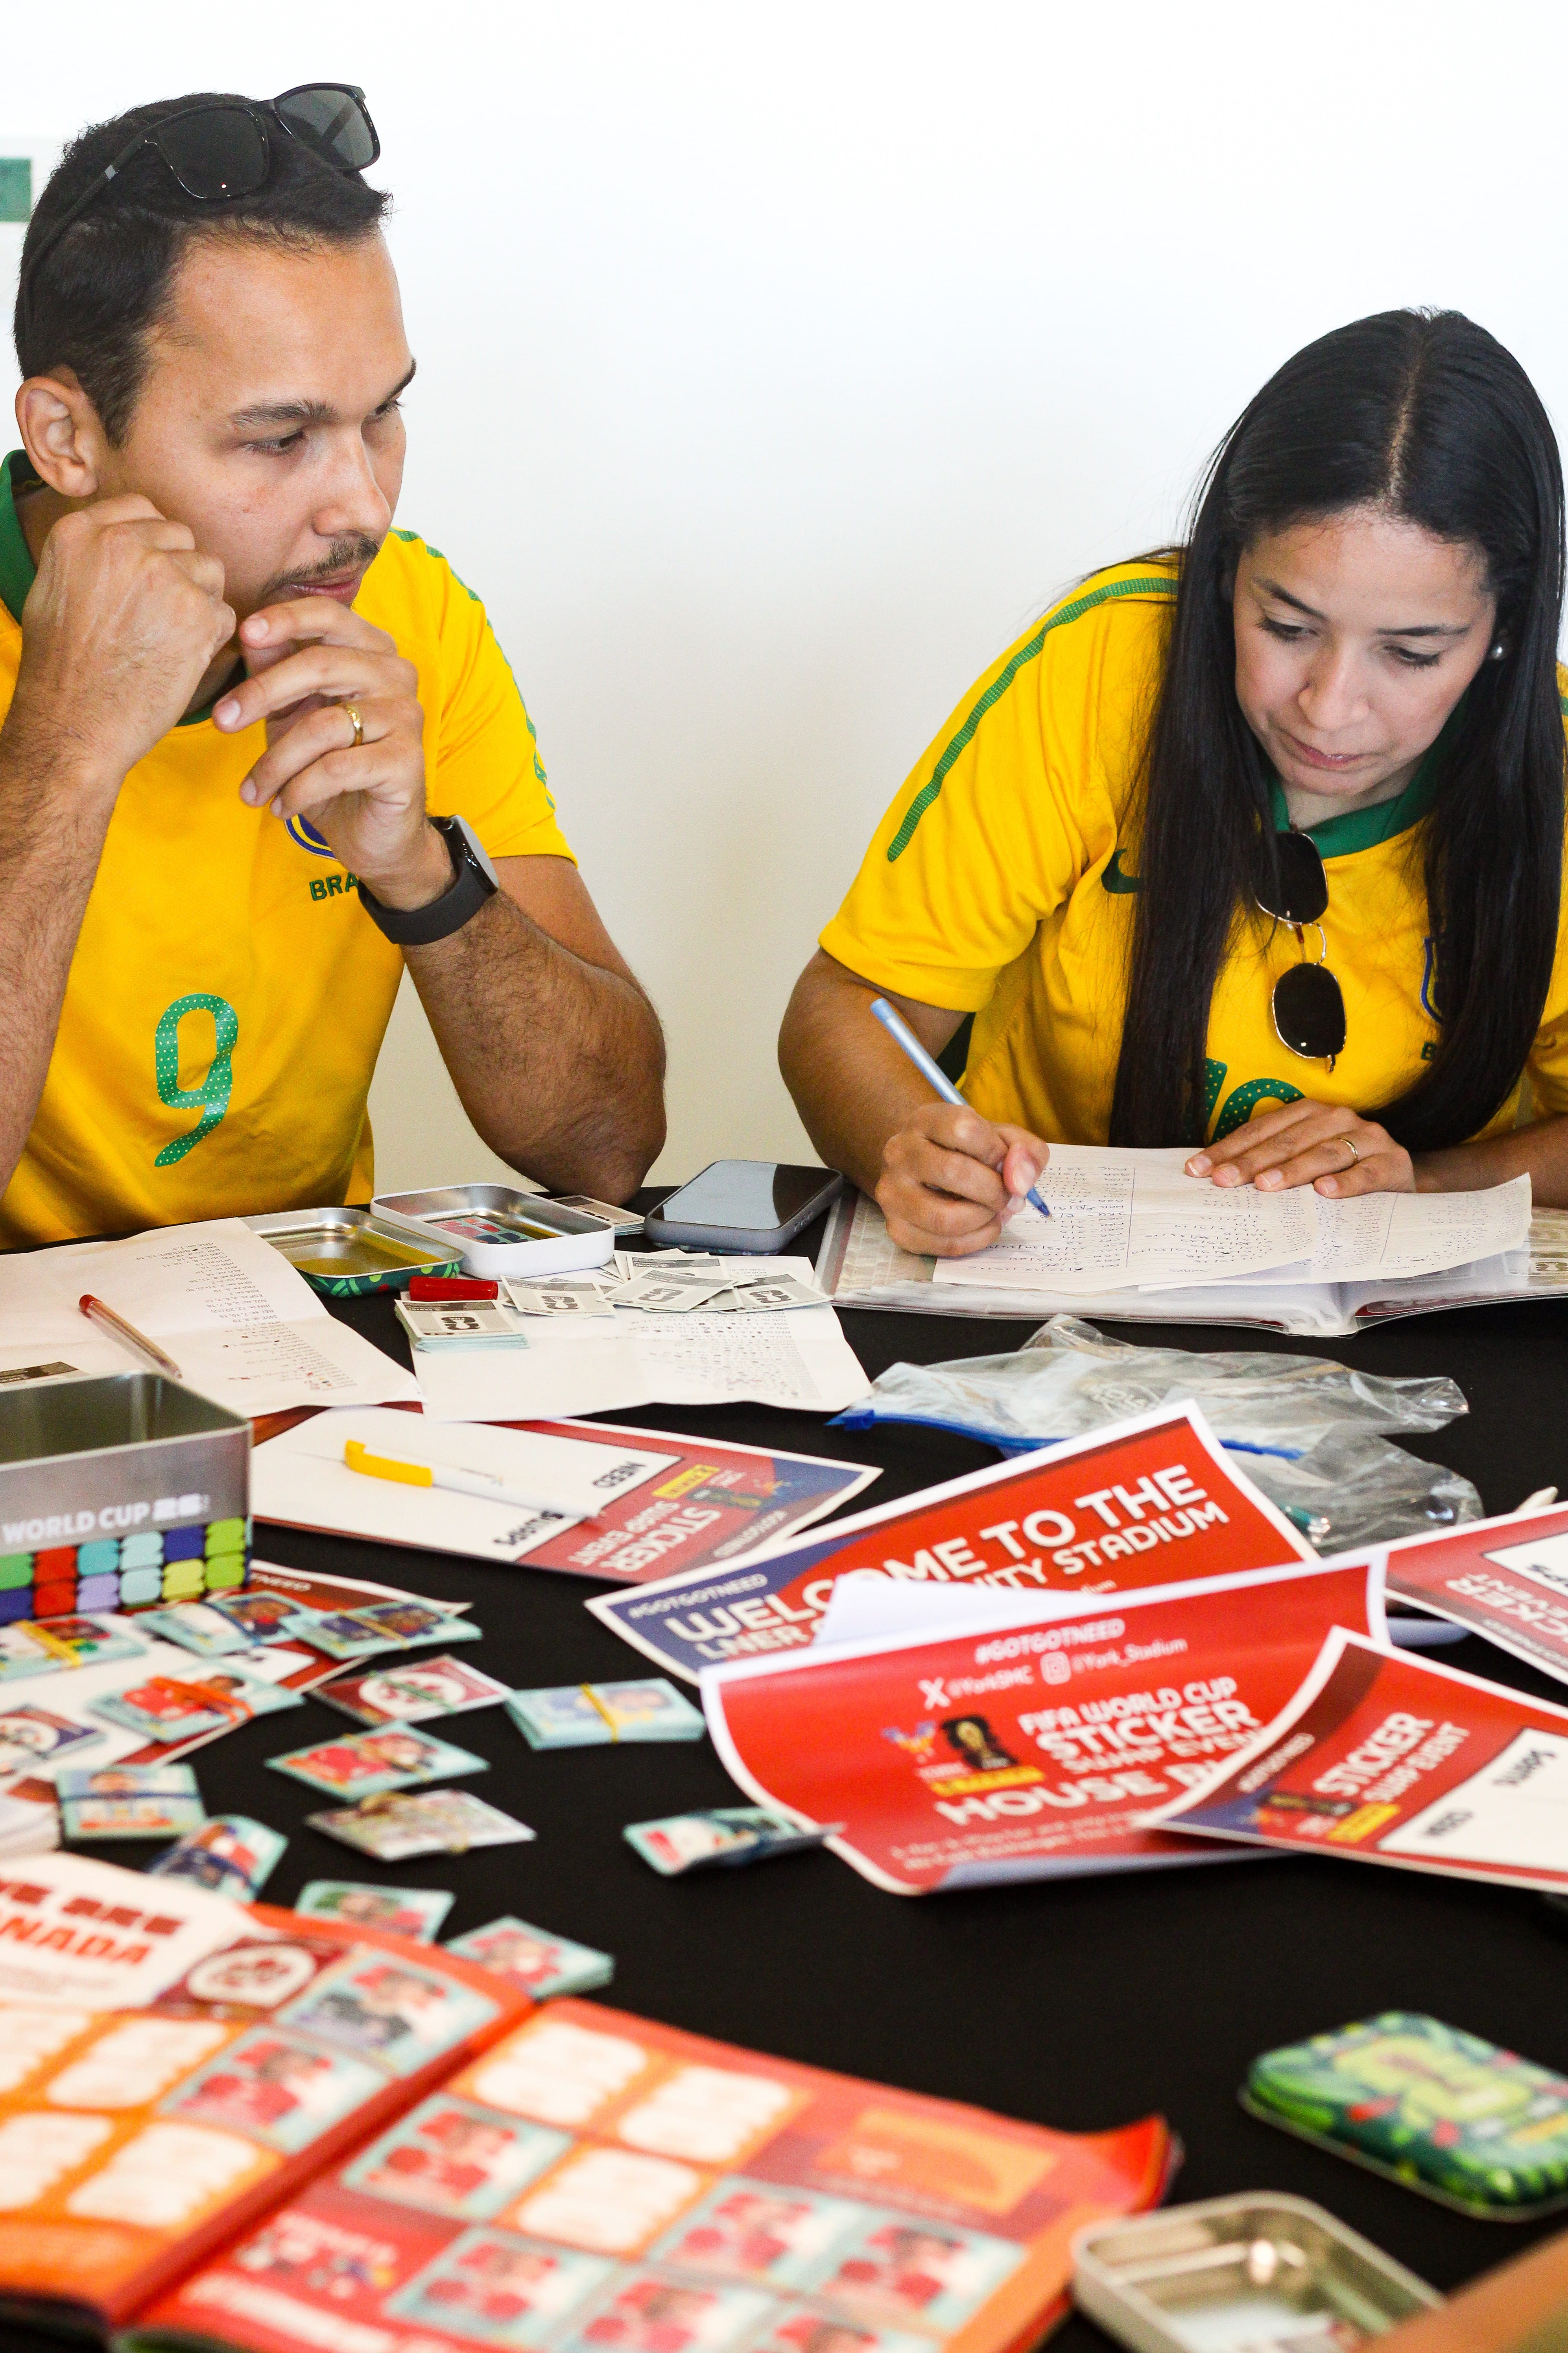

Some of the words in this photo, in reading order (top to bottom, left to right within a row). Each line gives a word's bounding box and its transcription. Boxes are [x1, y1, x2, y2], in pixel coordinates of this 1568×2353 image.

[155, 993, 238, 1167] 9
[1, 1510, 96, 1544] WORLD
[98, 1501, 150, 1531] CUP
[598, 1507, 721, 1572] STICKER
[979, 1509, 1076, 1559] TO
[1075, 1464, 1207, 1528] THE
[1052, 1500, 1230, 1576] STADIUM
[974, 1618, 1125, 1665] #GOTGOTNEED
[1018, 1705, 1081, 1737] FIFA
[1077, 1686, 1183, 1725] WORLD
[1182, 1676, 1238, 1706] CUP
[1036, 1700, 1262, 1761] STICKER
[1313, 1711, 1435, 1796] STICKER
[935, 1769, 1168, 1826] HOUSE
